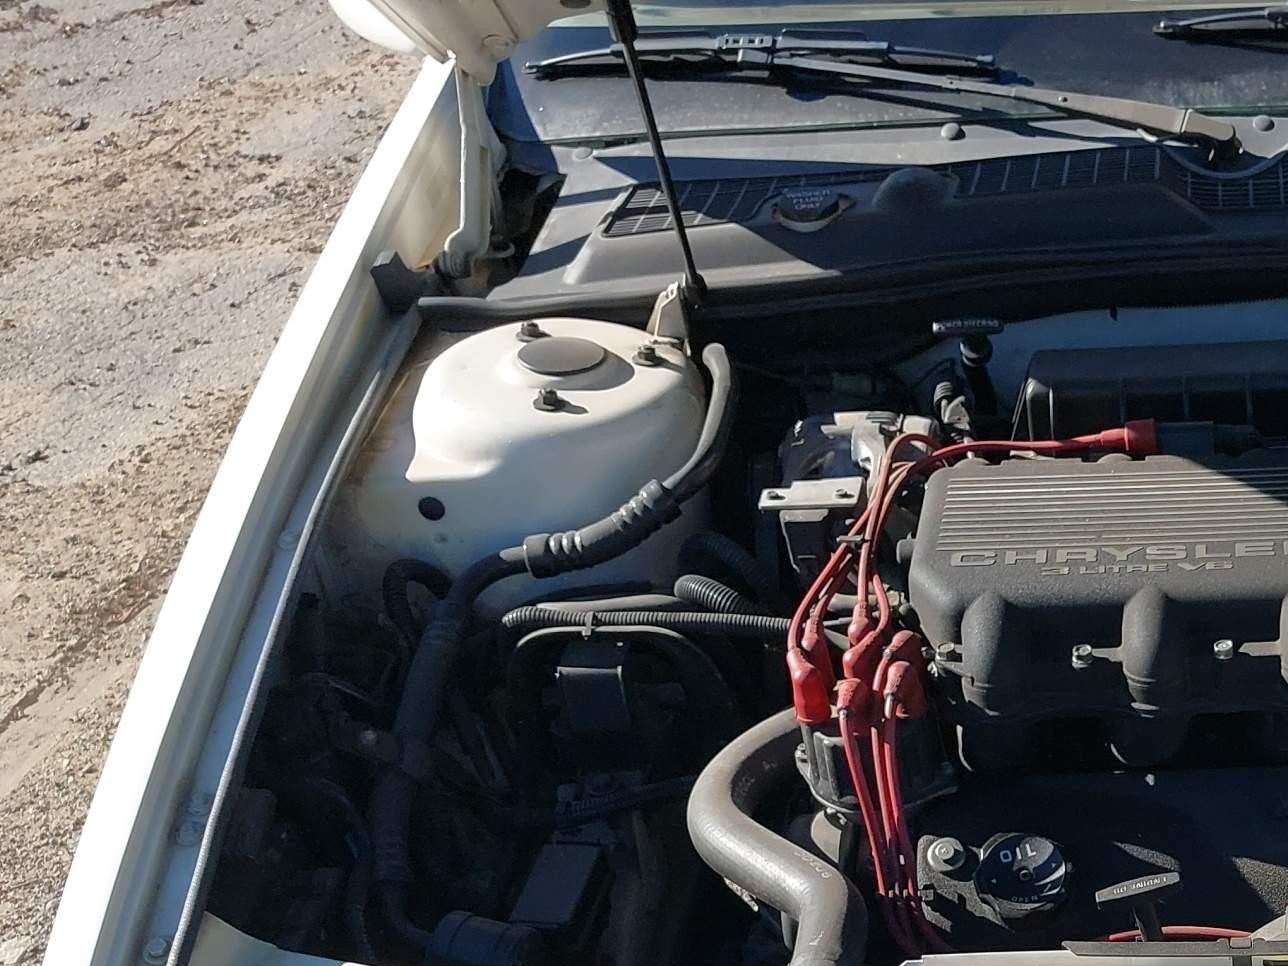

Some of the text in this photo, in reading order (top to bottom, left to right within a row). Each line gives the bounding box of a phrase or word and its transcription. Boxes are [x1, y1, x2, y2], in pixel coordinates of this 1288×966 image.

[1040, 561, 1233, 576] 3 LITRE V6
[1000, 843, 1037, 863] OIL
